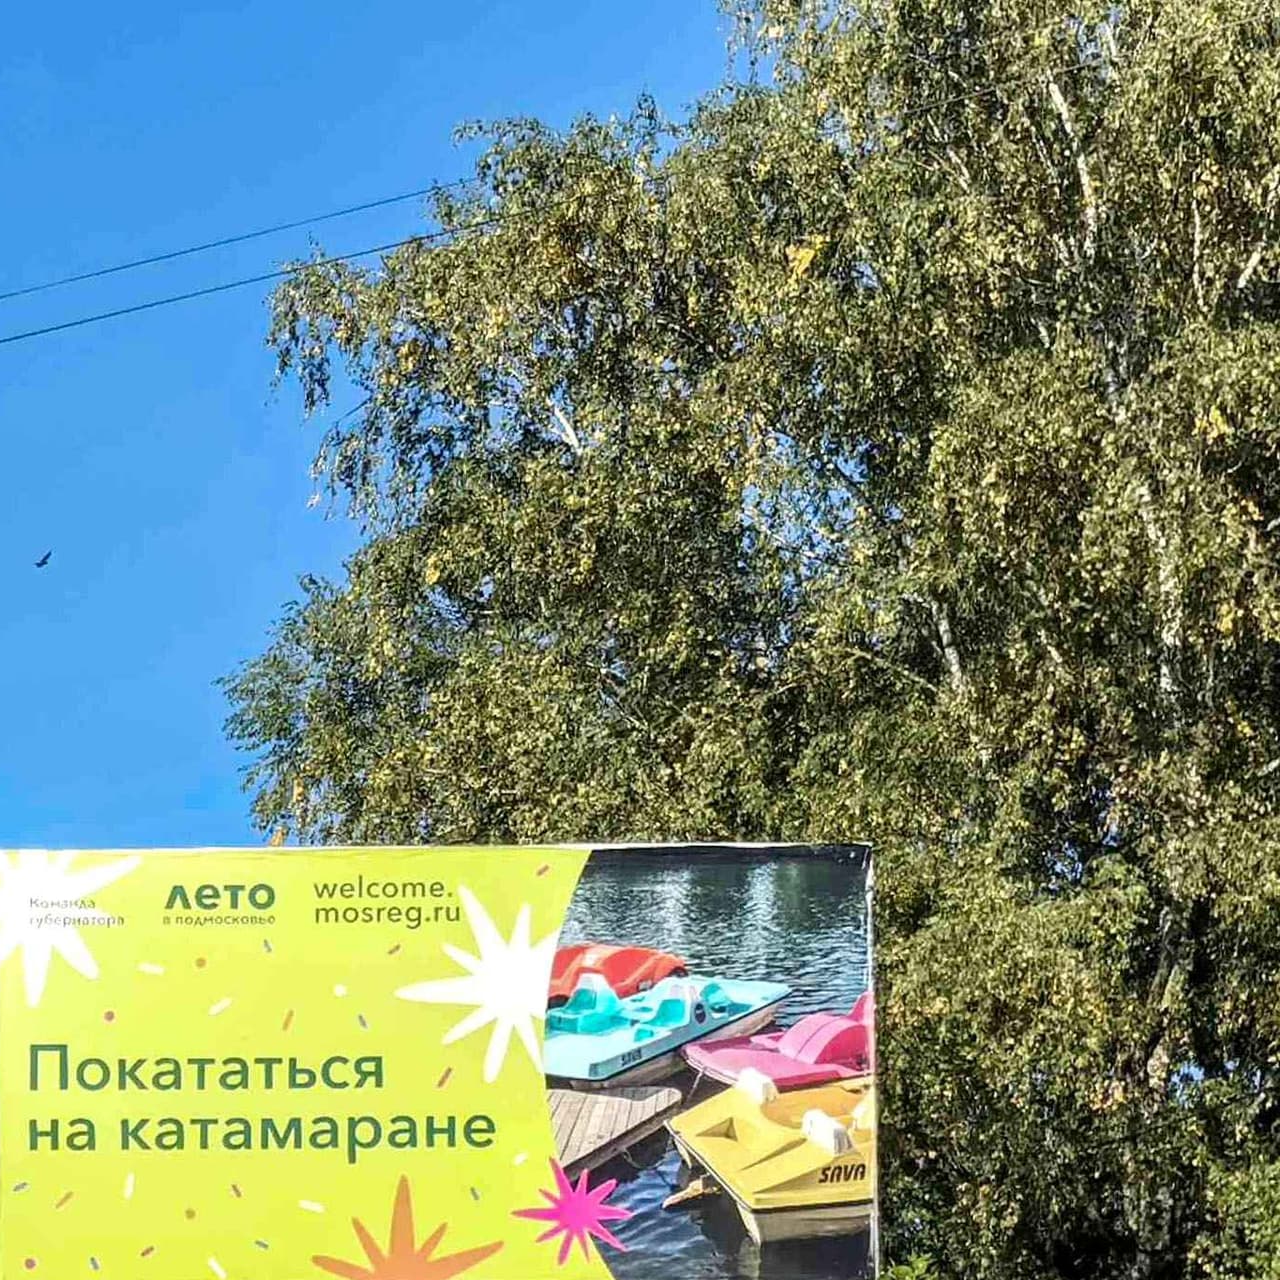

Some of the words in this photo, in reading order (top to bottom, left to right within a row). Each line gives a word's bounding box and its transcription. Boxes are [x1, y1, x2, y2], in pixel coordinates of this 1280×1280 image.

[313, 874, 453, 899] welcome.
[29, 897, 96, 910] Команда
[29, 915, 125, 928] губернатора
[315, 905, 461, 929] mosreg.ru
[29, 1043, 384, 1091] Покататься
[29, 1117, 96, 1152] на
[121, 1112, 497, 1164] катамаране
